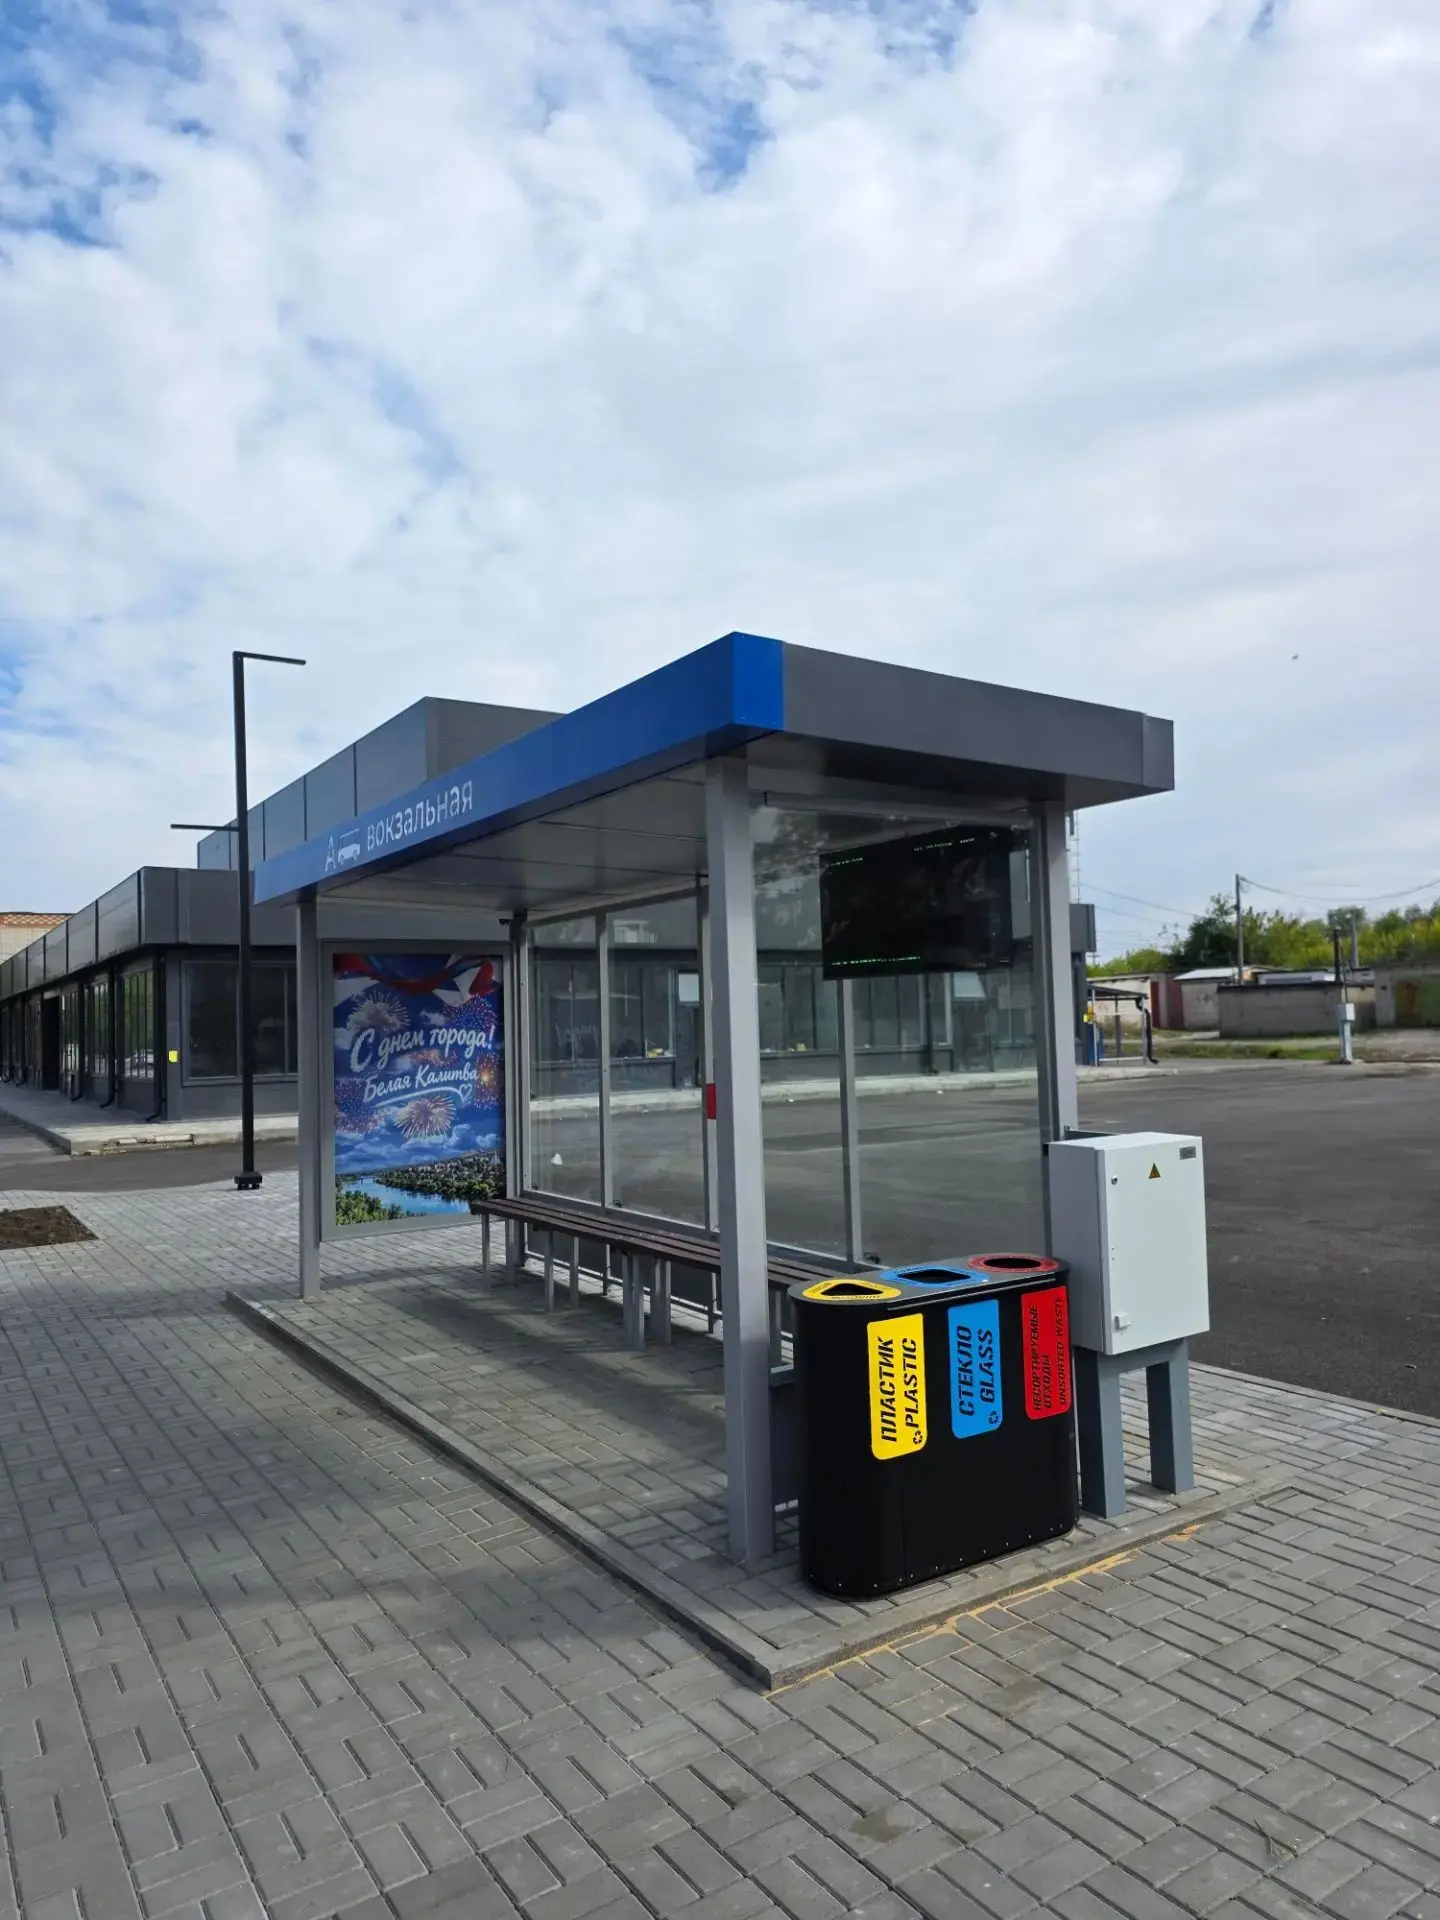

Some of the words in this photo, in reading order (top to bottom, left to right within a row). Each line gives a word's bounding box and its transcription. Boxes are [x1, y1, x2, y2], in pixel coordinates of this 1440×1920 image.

[367, 780, 473, 851] вокзальная
[350, 1028, 375, 1073] С
[377, 1028, 425, 1070] днем
[429, 1024, 495, 1058] города!
[363, 1075, 411, 1102] Белая
[415, 1062, 480, 1088] Калитва
[878, 1336, 897, 1442] ПЛАСТИК
[902, 1338, 919, 1428] PLASTIC
[956, 1325, 974, 1417] СТЕКЛО
[978, 1328, 995, 1404] GLASS
[1029, 1303, 1041, 1411] НЕСОРТИРУЕМЫЕ
[1056, 1341, 1067, 1405] UNSORTED
